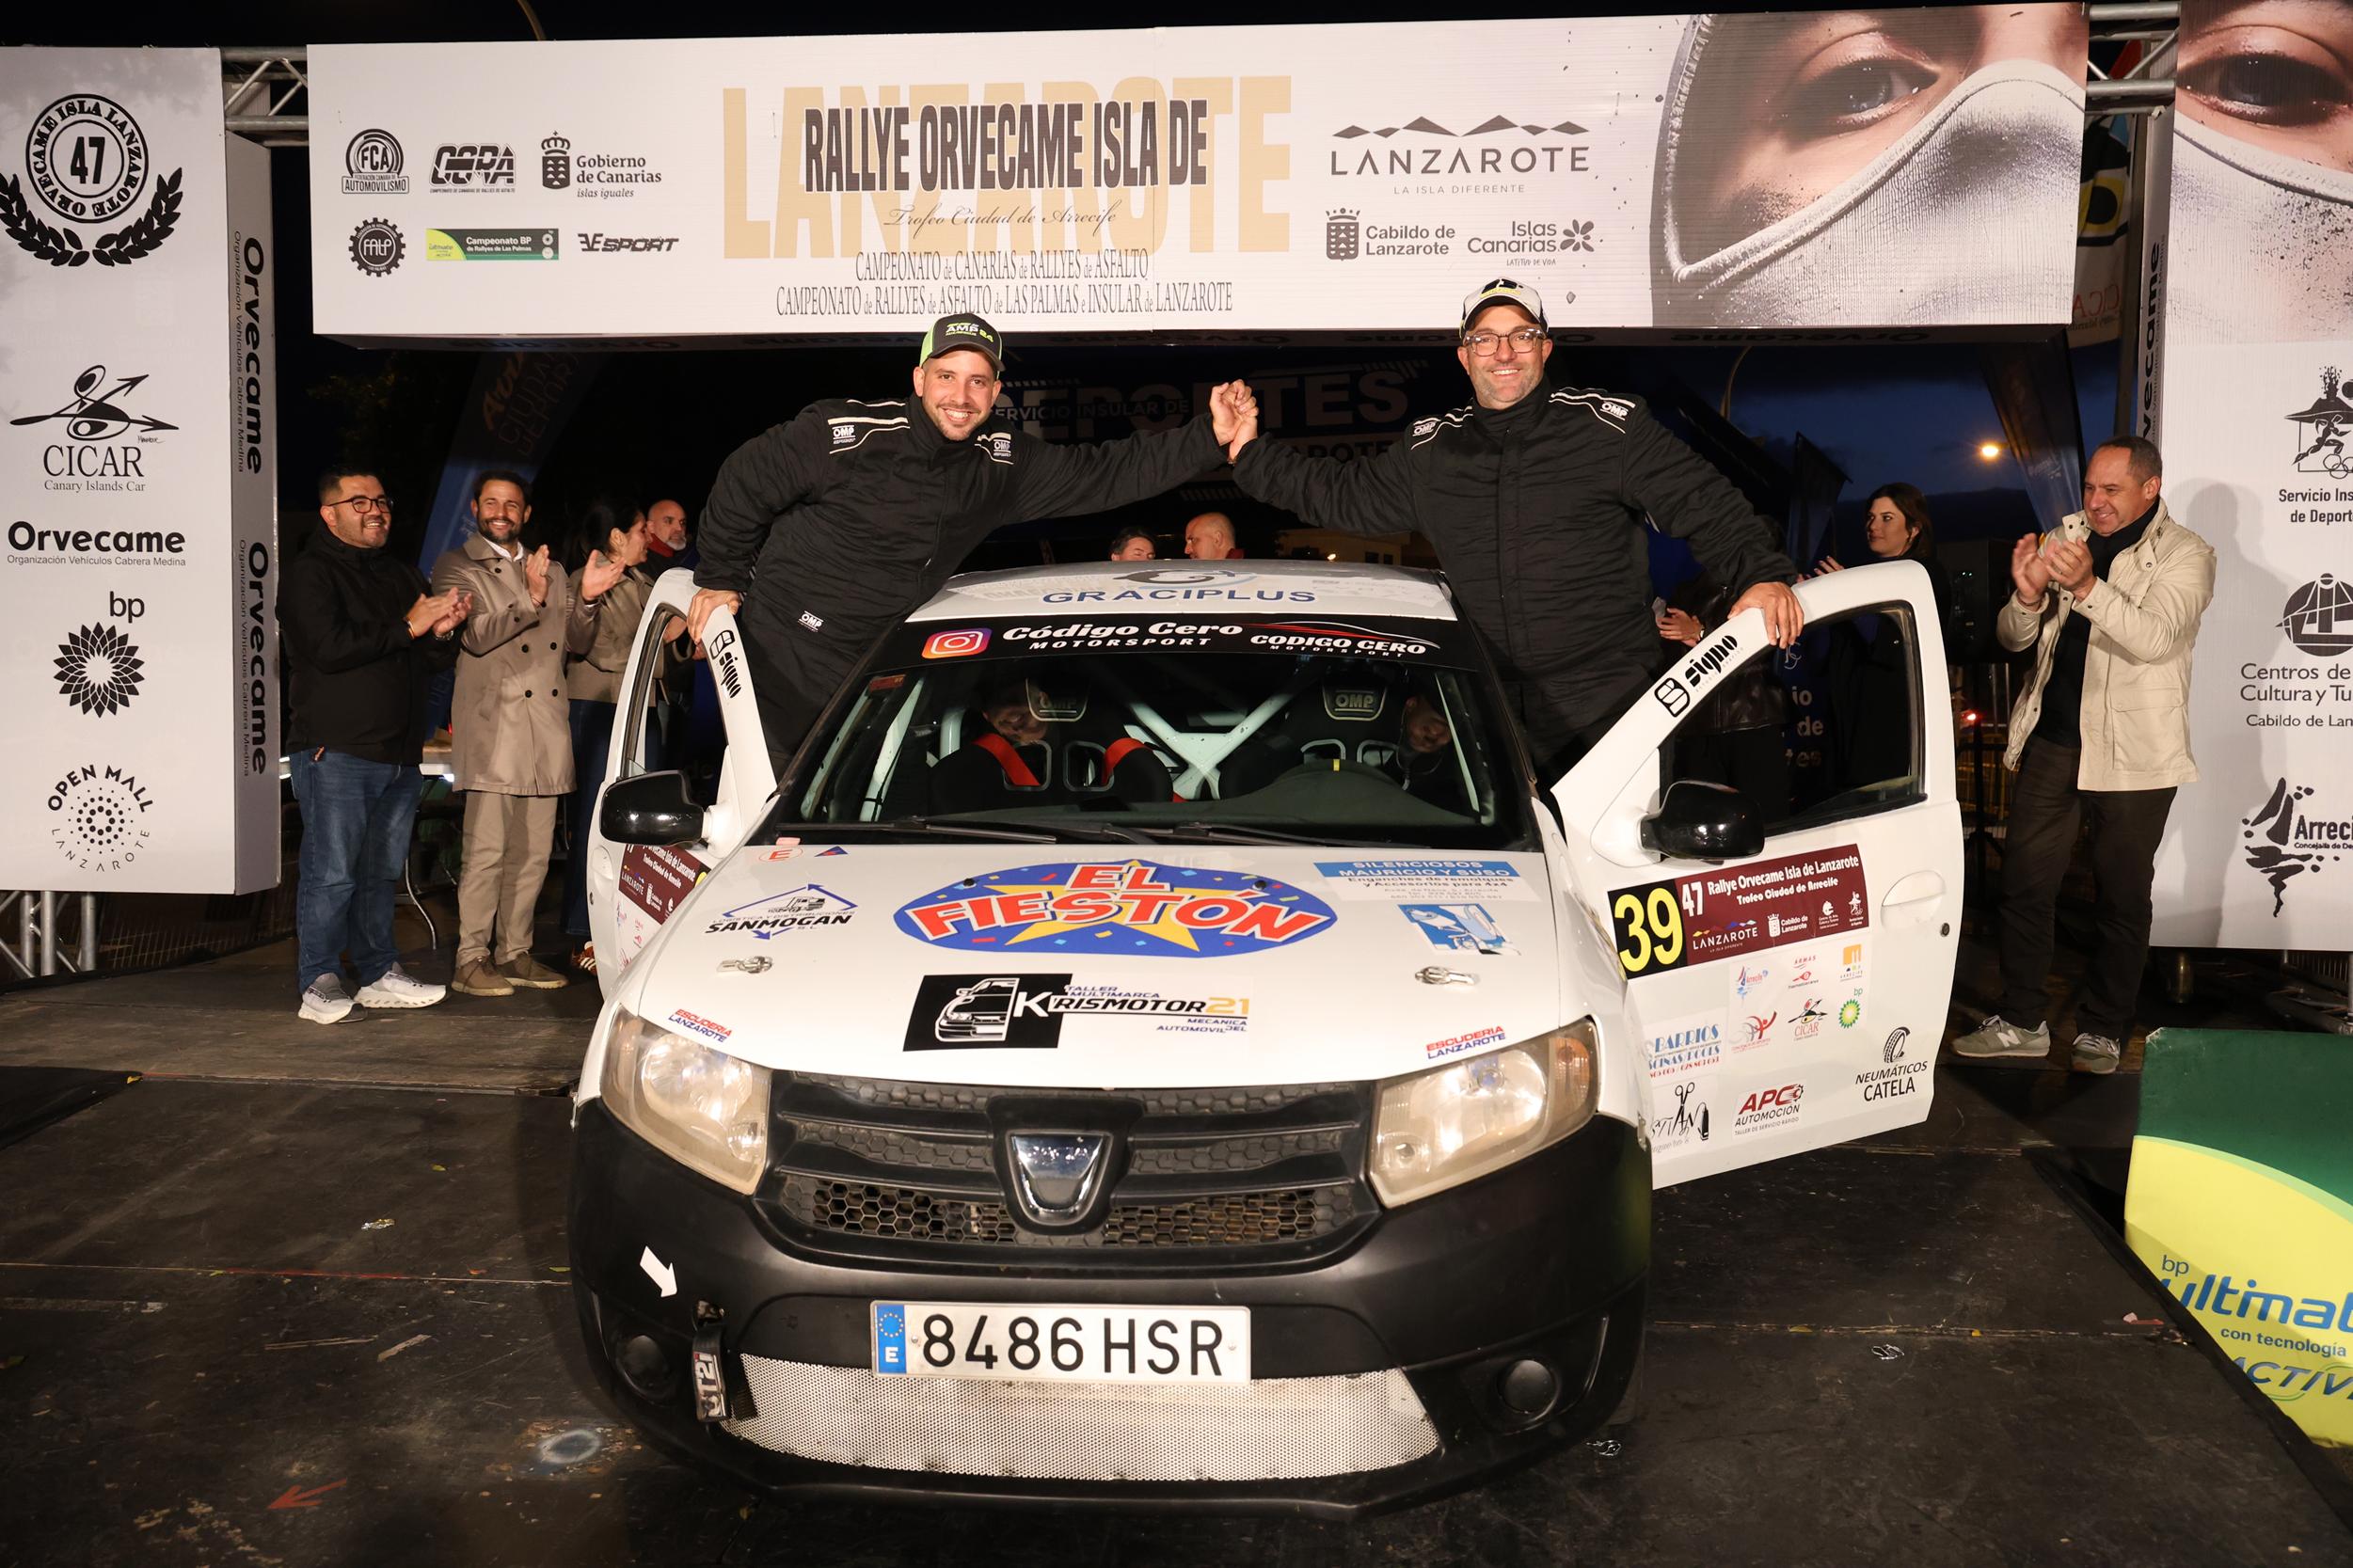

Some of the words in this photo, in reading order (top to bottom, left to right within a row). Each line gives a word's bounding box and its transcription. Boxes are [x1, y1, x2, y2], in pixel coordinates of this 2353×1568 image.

[57, 99, 102, 122] ISLA
[805, 106, 910, 193] RALLYE
[919, 101, 1083, 191] ORVECAME
[1093, 100, 1158, 188] ISLA
[1169, 98, 1209, 186] DE
[71, 136, 105, 184] 47
[361, 145, 390, 171] FCA
[577, 154, 646, 168] Gobierno
[1330, 146, 1590, 176] LANZAROTE
[344, 180, 406, 193] AUTOMOVILISMO
[577, 170, 594, 183] de
[596, 170, 661, 183] Canarias
[577, 188, 599, 198] islas
[600, 188, 634, 199] iguales
[1393, 186, 1411, 195] LA
[1416, 185, 1445, 195] ISLA
[1452, 184, 1525, 195] DIFERENTE
[883, 203, 945, 240] Trofeo
[951, 205, 1012, 226] Ciudad
[1017, 206, 1036, 225] de
[1041, 199, 1122, 237] Arrecife
[1512, 221, 1557, 236] Islas
[466, 236, 518, 246] Campeonato
[520, 236, 532, 245] BP
[1365, 225, 1430, 239] Cabildo
[1435, 224, 1456, 239] de
[1365, 241, 1450, 256] Lanzarote
[855, 251, 941, 281] CAMPEONATO
[944, 258, 952, 280] de
[955, 250, 1016, 280] CANARIAS
[1019, 257, 1027, 278] de
[1030, 249, 1081, 279] RALLYES
[1084, 256, 1092, 277] de
[1094, 248, 1149, 279] ASFALTO
[777, 286, 861, 315] CAMPEONATO
[864, 293, 872, 315] de
[875, 285, 926, 315] RALLYES
[928, 293, 936, 314] de
[939, 285, 991, 315] ASFALTO
[994, 293, 1003, 313] de
[1006, 285, 1028, 314] LAS
[1030, 284, 1079, 313] PALMAS
[1088, 283, 1143, 313] INSULAR
[1144, 291, 1153, 312] de
[1155, 281, 1233, 311] LANZAROTE
[243, 237, 265, 475] Orvecame
[1601, 403, 1629, 417] OMP
[834, 427, 854, 436] OMP
[1414, 423, 1435, 435] OMP
[994, 441, 1010, 451] OMP
[43, 445, 144, 477] CICAR
[44, 480, 83, 493] Canary
[86, 481, 123, 492] Islands
[126, 482, 146, 492] Car
[2279, 488, 2331, 502] Servicio
[2290, 509, 2306, 523] de
[8, 521, 185, 553] Orvecame
[7, 555, 66, 566] Organización
[69, 555, 112, 565] Vehículos
[114, 556, 151, 566] Cabrera
[153, 557, 186, 566] Medina
[1041, 588, 1316, 604] GRACIPLUS
[110, 591, 145, 624] bp
[802, 613, 822, 628] OMP
[1002, 623, 1143, 641] Código
[1147, 621, 1244, 638] Cero
[1029, 638, 1212, 651] MOTORSPORT
[1250, 634, 1354, 650] CODIGO
[1357, 641, 1427, 656] CERO
[1269, 645, 1404, 657] MOTORSPORT
[248, 542, 270, 776] Orvecame
[2240, 662, 2320, 680] Centros
[2327, 663, 2352, 680] de
[2240, 684, 2313, 702] Cultura
[2315, 689, 2328, 706] y
[2330, 685, 2352, 702] Tu
[2246, 714, 2301, 727] Cabildo
[2305, 714, 2324, 727] de
[47, 764, 97, 811] OPEN
[104, 765, 153, 813] MALL
[52, 828, 151, 872] LANZAROTE
[1064, 863, 1172, 893] EL
[1681, 880, 1703, 918] 47
[1708, 878, 1738, 896] Rallye
[1738, 869, 1785, 890] Orvecame
[1785, 864, 1802, 880] Isla
[1803, 862, 1815, 878] de
[1815, 855, 1859, 875] Lanzarote
[1737, 892, 1764, 906] Trofeo
[1764, 885, 1795, 900] Ciudad
[1796, 882, 1806, 894] de
[1807, 877, 1838, 892] Arrecife
[705, 914, 852, 934] SANMOGAN
[904, 889, 1331, 942] FIESTÓN
[1614, 887, 1684, 973] 39
[1693, 927, 1759, 950] LANZAROTE
[1781, 923, 1807, 934] Lanzarote
[1853, 988, 1864, 997] bp
[1205, 996, 1249, 1015] 21
[668, 1014, 727, 1043] LANZAROTE
[675, 1008, 733, 1037] ESCUDERIA
[1187, 1018, 1248, 1026] MECANICA
[1794, 1022, 1820, 1037] CICAR
[1426, 1026, 1504, 1052] ESCUDERIA
[1427, 1033, 1505, 1060] LANZAROTE
[1855, 1060, 1929, 1085] NEUMÁTICOS
[1864, 1076, 1916, 1103] CATELA
[1735, 1104, 1800, 1127] AUTOMOCIÓN
[2162, 1255, 2189, 1276] bp
[923, 1314, 1084, 1371] 8486
[1104, 1318, 1222, 1376] HSR
[2220, 1327, 2251, 1342] con
[2256, 1332, 2346, 1357] tecnología
[884, 1346, 898, 1363] E
